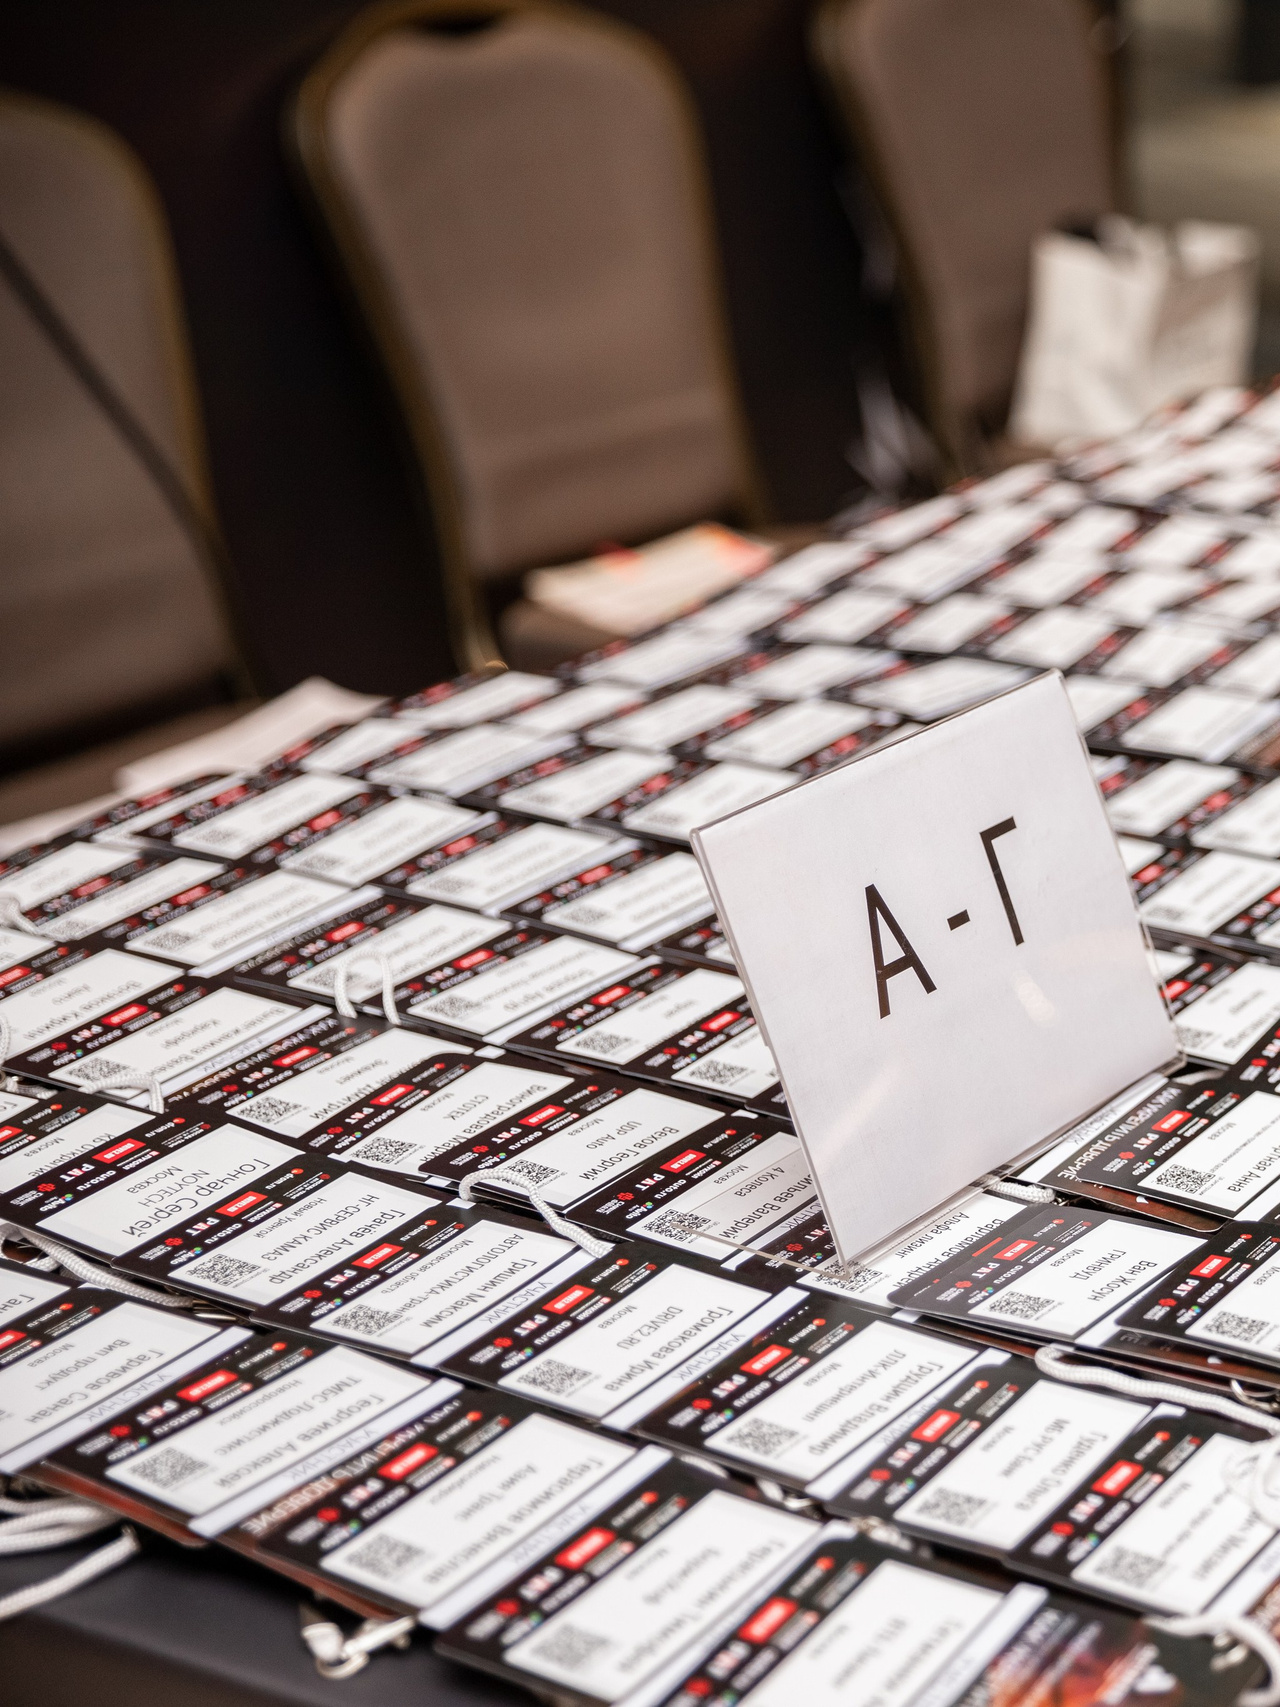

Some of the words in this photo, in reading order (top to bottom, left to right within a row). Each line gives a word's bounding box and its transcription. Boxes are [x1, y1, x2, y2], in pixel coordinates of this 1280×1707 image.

[419, 1092, 455, 1112] Москва
[442, 1094, 491, 1121] СТОТЕК
[460, 1083, 548, 1134] Виноградова
[143, 1121, 175, 1138] drom.ru
[507, 1130, 543, 1150] auto.ru
[566, 1117, 604, 1137] Москва
[613, 1120, 642, 1135] UDP
[632, 1126, 680, 1149] Вехов
[1206, 1121, 1238, 1141] Москва
[22, 1137, 65, 1157] Москва
[417, 1134, 468, 1163] Мария
[584, 1133, 617, 1150] Auto
[702, 1133, 728, 1149] drom.ru
[27, 1142, 96, 1177] Открытие
[476, 1156, 501, 1169] Avito
[576, 1147, 640, 1181] Георгий
[75, 1169, 117, 1191] auto.ru
[125, 1165, 184, 1194] Москва
[190, 1158, 271, 1197] Гончар
[264, 1172, 295, 1190] drom.ru
[712, 1164, 749, 1185] Москва
[733, 1171, 779, 1197] Колеса
[1225, 1170, 1263, 1193] Анна
[136, 1169, 211, 1208] NOYTECH
[653, 1178, 688, 1199] auto.ru
[38, 1198, 66, 1212] Avito
[120, 1196, 201, 1238] Сергей
[290, 1197, 328, 1217] Новый
[305, 1194, 380, 1235] НГ-СЕРВИС
[624, 1206, 648, 1220] Avito
[203, 1223, 243, 1244] auto.ru
[252, 1215, 296, 1239] Уренгой
[347, 1208, 406, 1239] Грачёв
[398, 1224, 429, 1242] drom.ru
[717, 1202, 782, 1239] Валерий
[928, 1211, 971, 1235] Альфа
[259, 1233, 313, 1261] КАМАЗ
[893, 1233, 934, 1259] лизинг
[939, 1218, 1009, 1259] Варламов
[168, 1251, 196, 1265] Avito
[266, 1237, 355, 1285] Александр
[415, 1238, 474, 1273] Московская
[1048, 1248, 1084, 1268] Москва
[1068, 1248, 1127, 1281] ГРИНВУД
[1124, 1259, 1157, 1276] Ван
[342, 1273, 382, 1296] auto.ru
[379, 1271, 421, 1294] область
[476, 1257, 538, 1293] Гришин
[589, 1264, 620, 1283] drom.ru
[889, 1257, 945, 1289] Андрей
[992, 1264, 1024, 1284] auto.ru
[1084, 1274, 1134, 1302] Жосун
[310, 1302, 336, 1317] Avito
[419, 1292, 485, 1328] Максим
[479, 1280, 553, 1324] УЧАСТНИК
[25, 1308, 62, 1328] drom.ru
[596, 1304, 638, 1329] Москва
[614, 1305, 683, 1350] DRIVE2.RU
[532, 1320, 573, 1345] auto.ru
[650, 1305, 734, 1360] Громакова
[26, 1342, 75, 1368] Москва
[94, 1339, 130, 1357] Вип
[672, 1332, 746, 1381] УЧАСТНИК
[32, 1356, 98, 1391] продукт
[83, 1348, 164, 1391] Гаривов
[603, 1358, 659, 1392] Ирина
[801, 1362, 842, 1387] Москва
[879, 1360, 945, 1403] Грудцин
[77, 1371, 172, 1422] УЧАСТНИК
[216, 1378, 303, 1426] Новороссийск
[309, 1376, 362, 1402] ТМБС
[24, 1391, 89, 1424] Санан
[295, 1393, 386, 1442] Георгиев
[151, 1409, 200, 1435] auto.ru
[213, 1400, 315, 1455] Лоджистикс
[805, 1402, 890, 1455] Владимир
[978, 1425, 1016, 1452] Москва
[1020, 1434, 1054, 1454] РУС
[213, 1441, 300, 1489] Алексей
[280, 1427, 378, 1481] УЧАСТНИК
[998, 1454, 1031, 1478] Банк
[1048, 1430, 1110, 1476] Гуденко
[425, 1455, 503, 1505] Новосибирск
[497, 1464, 539, 1491] Азия
[504, 1457, 606, 1523] Герасимов
[455, 1491, 504, 1522] Транс
[1012, 1477, 1064, 1511] Ольга
[422, 1524, 515, 1585] Вячеслав
